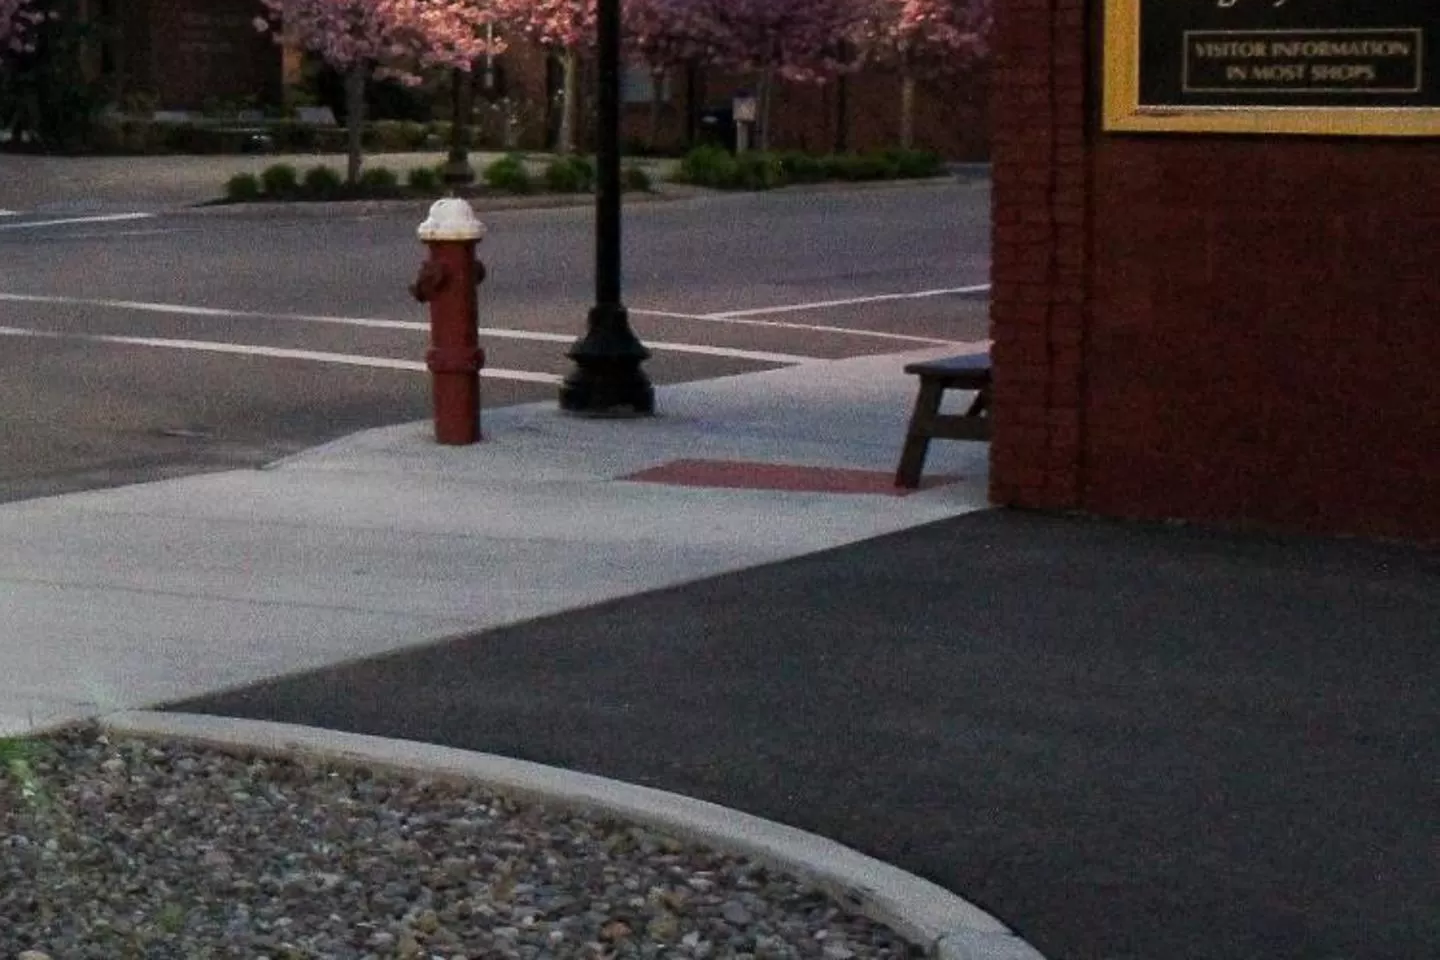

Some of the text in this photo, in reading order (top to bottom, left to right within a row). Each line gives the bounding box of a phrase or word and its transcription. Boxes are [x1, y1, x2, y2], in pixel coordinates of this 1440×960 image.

[1195, 40, 1411, 58] VISITOR INFORMATION
[1226, 65, 1248, 81] IN
